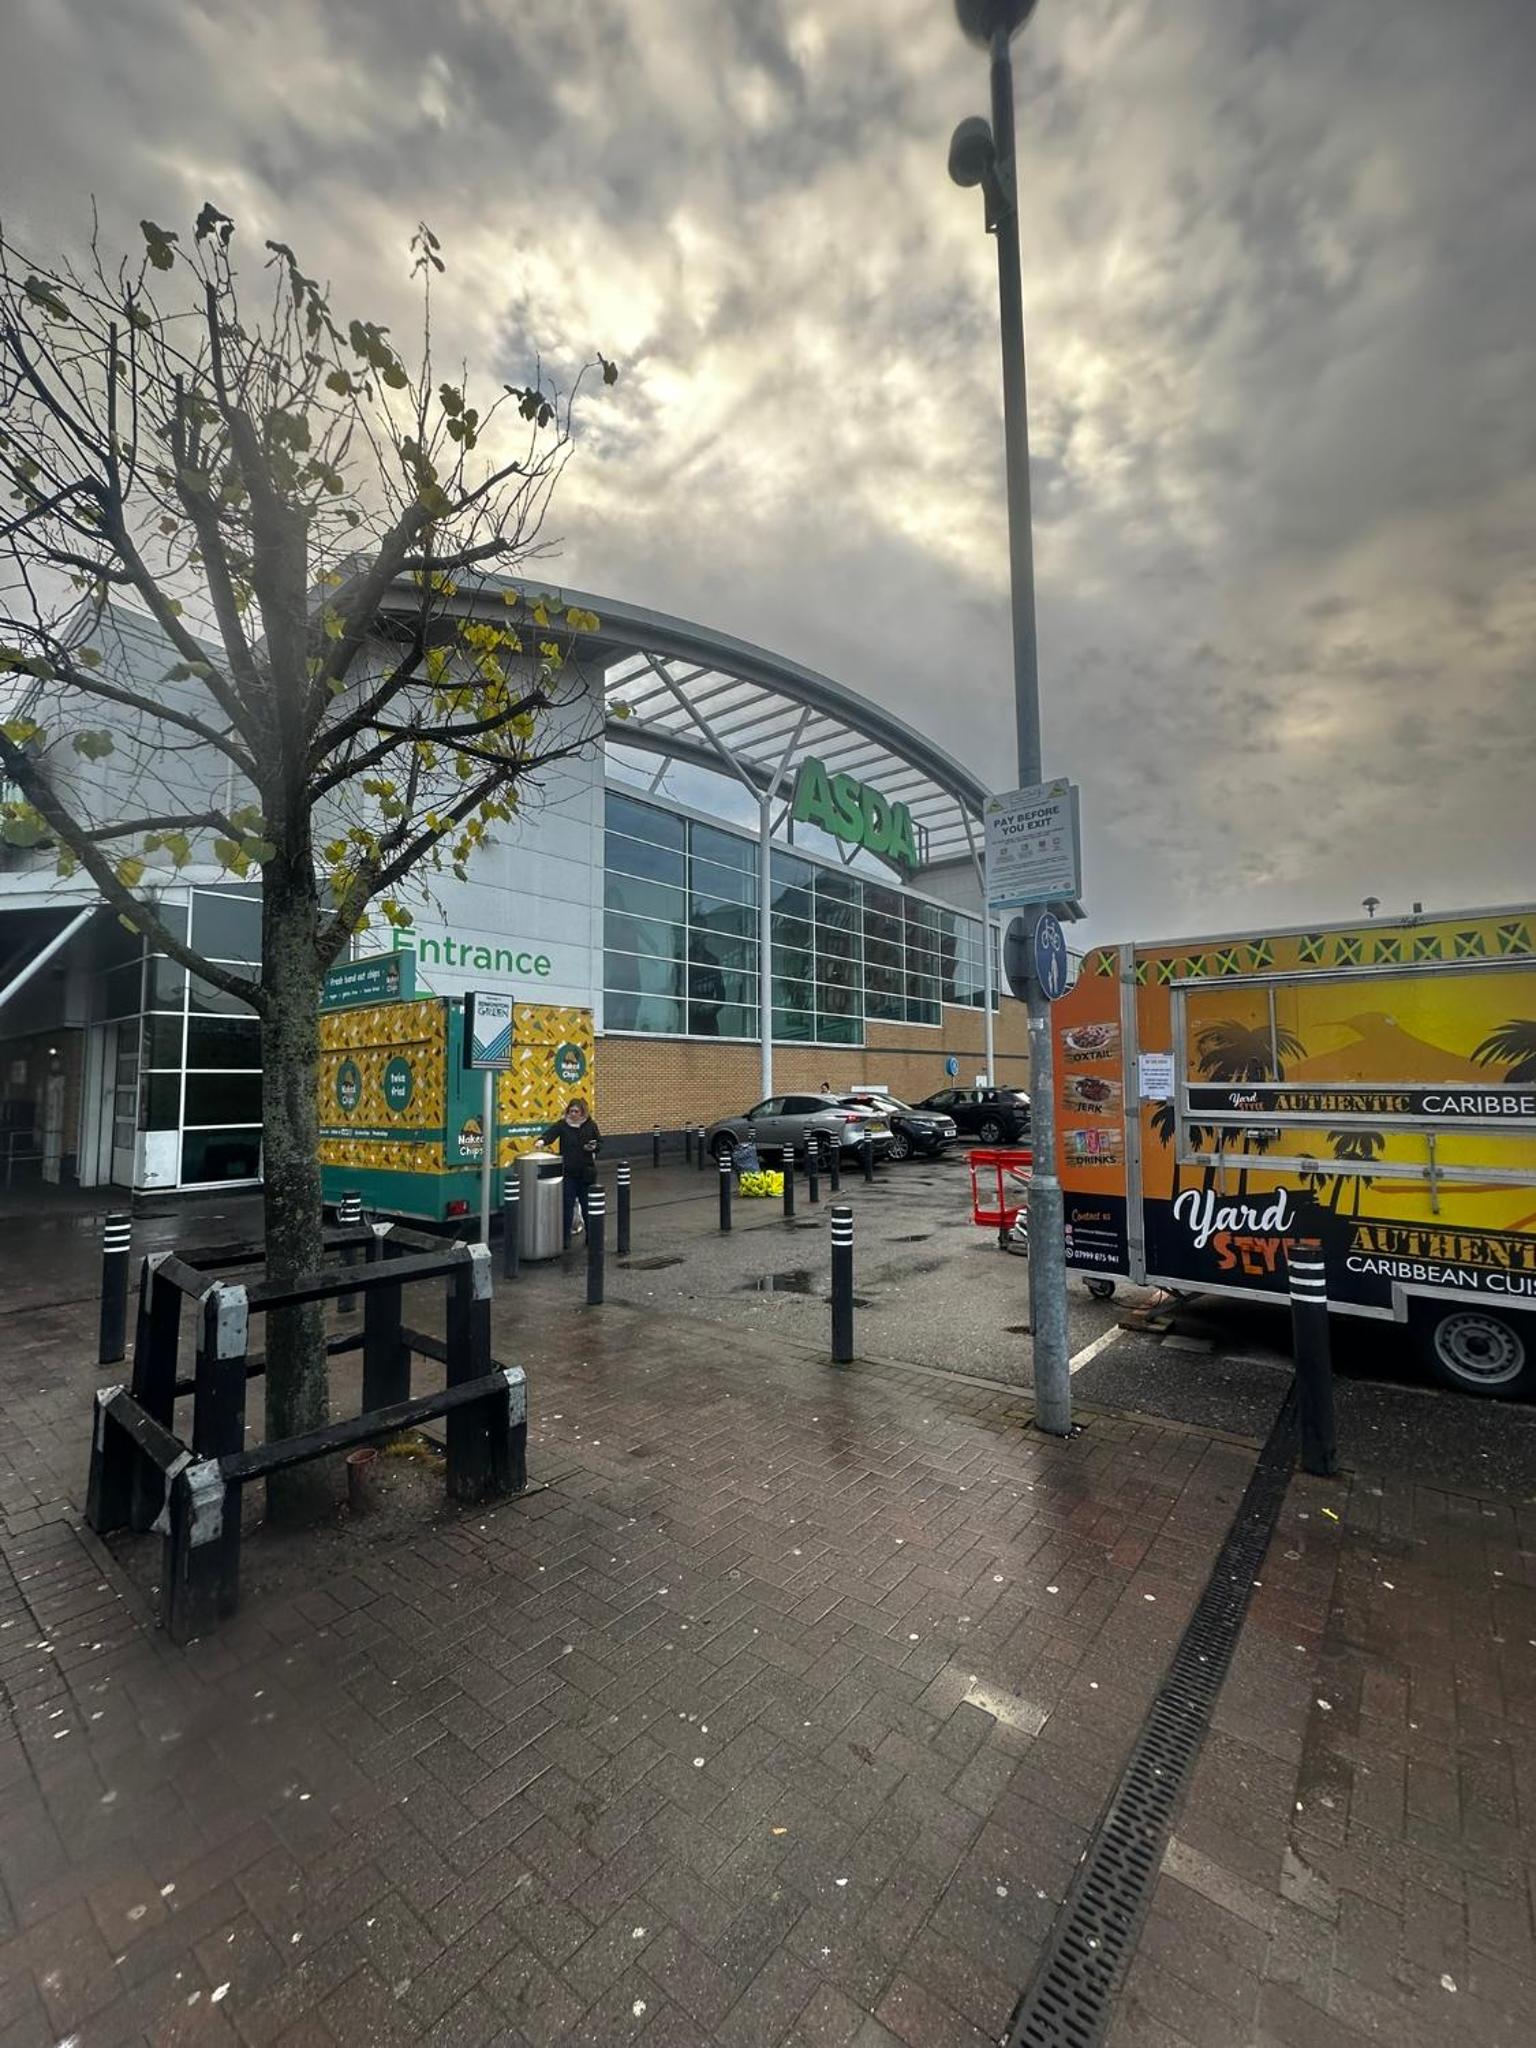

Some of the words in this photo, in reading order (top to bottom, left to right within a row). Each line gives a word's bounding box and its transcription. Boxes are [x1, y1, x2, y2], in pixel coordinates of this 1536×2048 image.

[792, 755, 920, 869] ASDA
[993, 815, 1014, 828] PAY
[1016, 805, 1060, 823] BEFORE
[1002, 823, 1025, 836] YOU
[1027, 817, 1053, 830] EXIT
[392, 928, 551, 977] Entrance
[1073, 1050, 1112, 1062] OXTAIL
[1077, 1102, 1104, 1113] JERK
[1229, 1092, 1257, 1107] Yard
[1275, 1094, 1411, 1112] AUTHENTIC
[1422, 1095, 1536, 1114] CARIBBE
[1076, 1155, 1117, 1165] DRINKS
[1071, 1208, 1101, 1222] Contact
[1173, 1188, 1295, 1248] Yard
[1213, 1232, 1322, 1275] STY
[1346, 1256, 1478, 1288] CARIBBEAN
